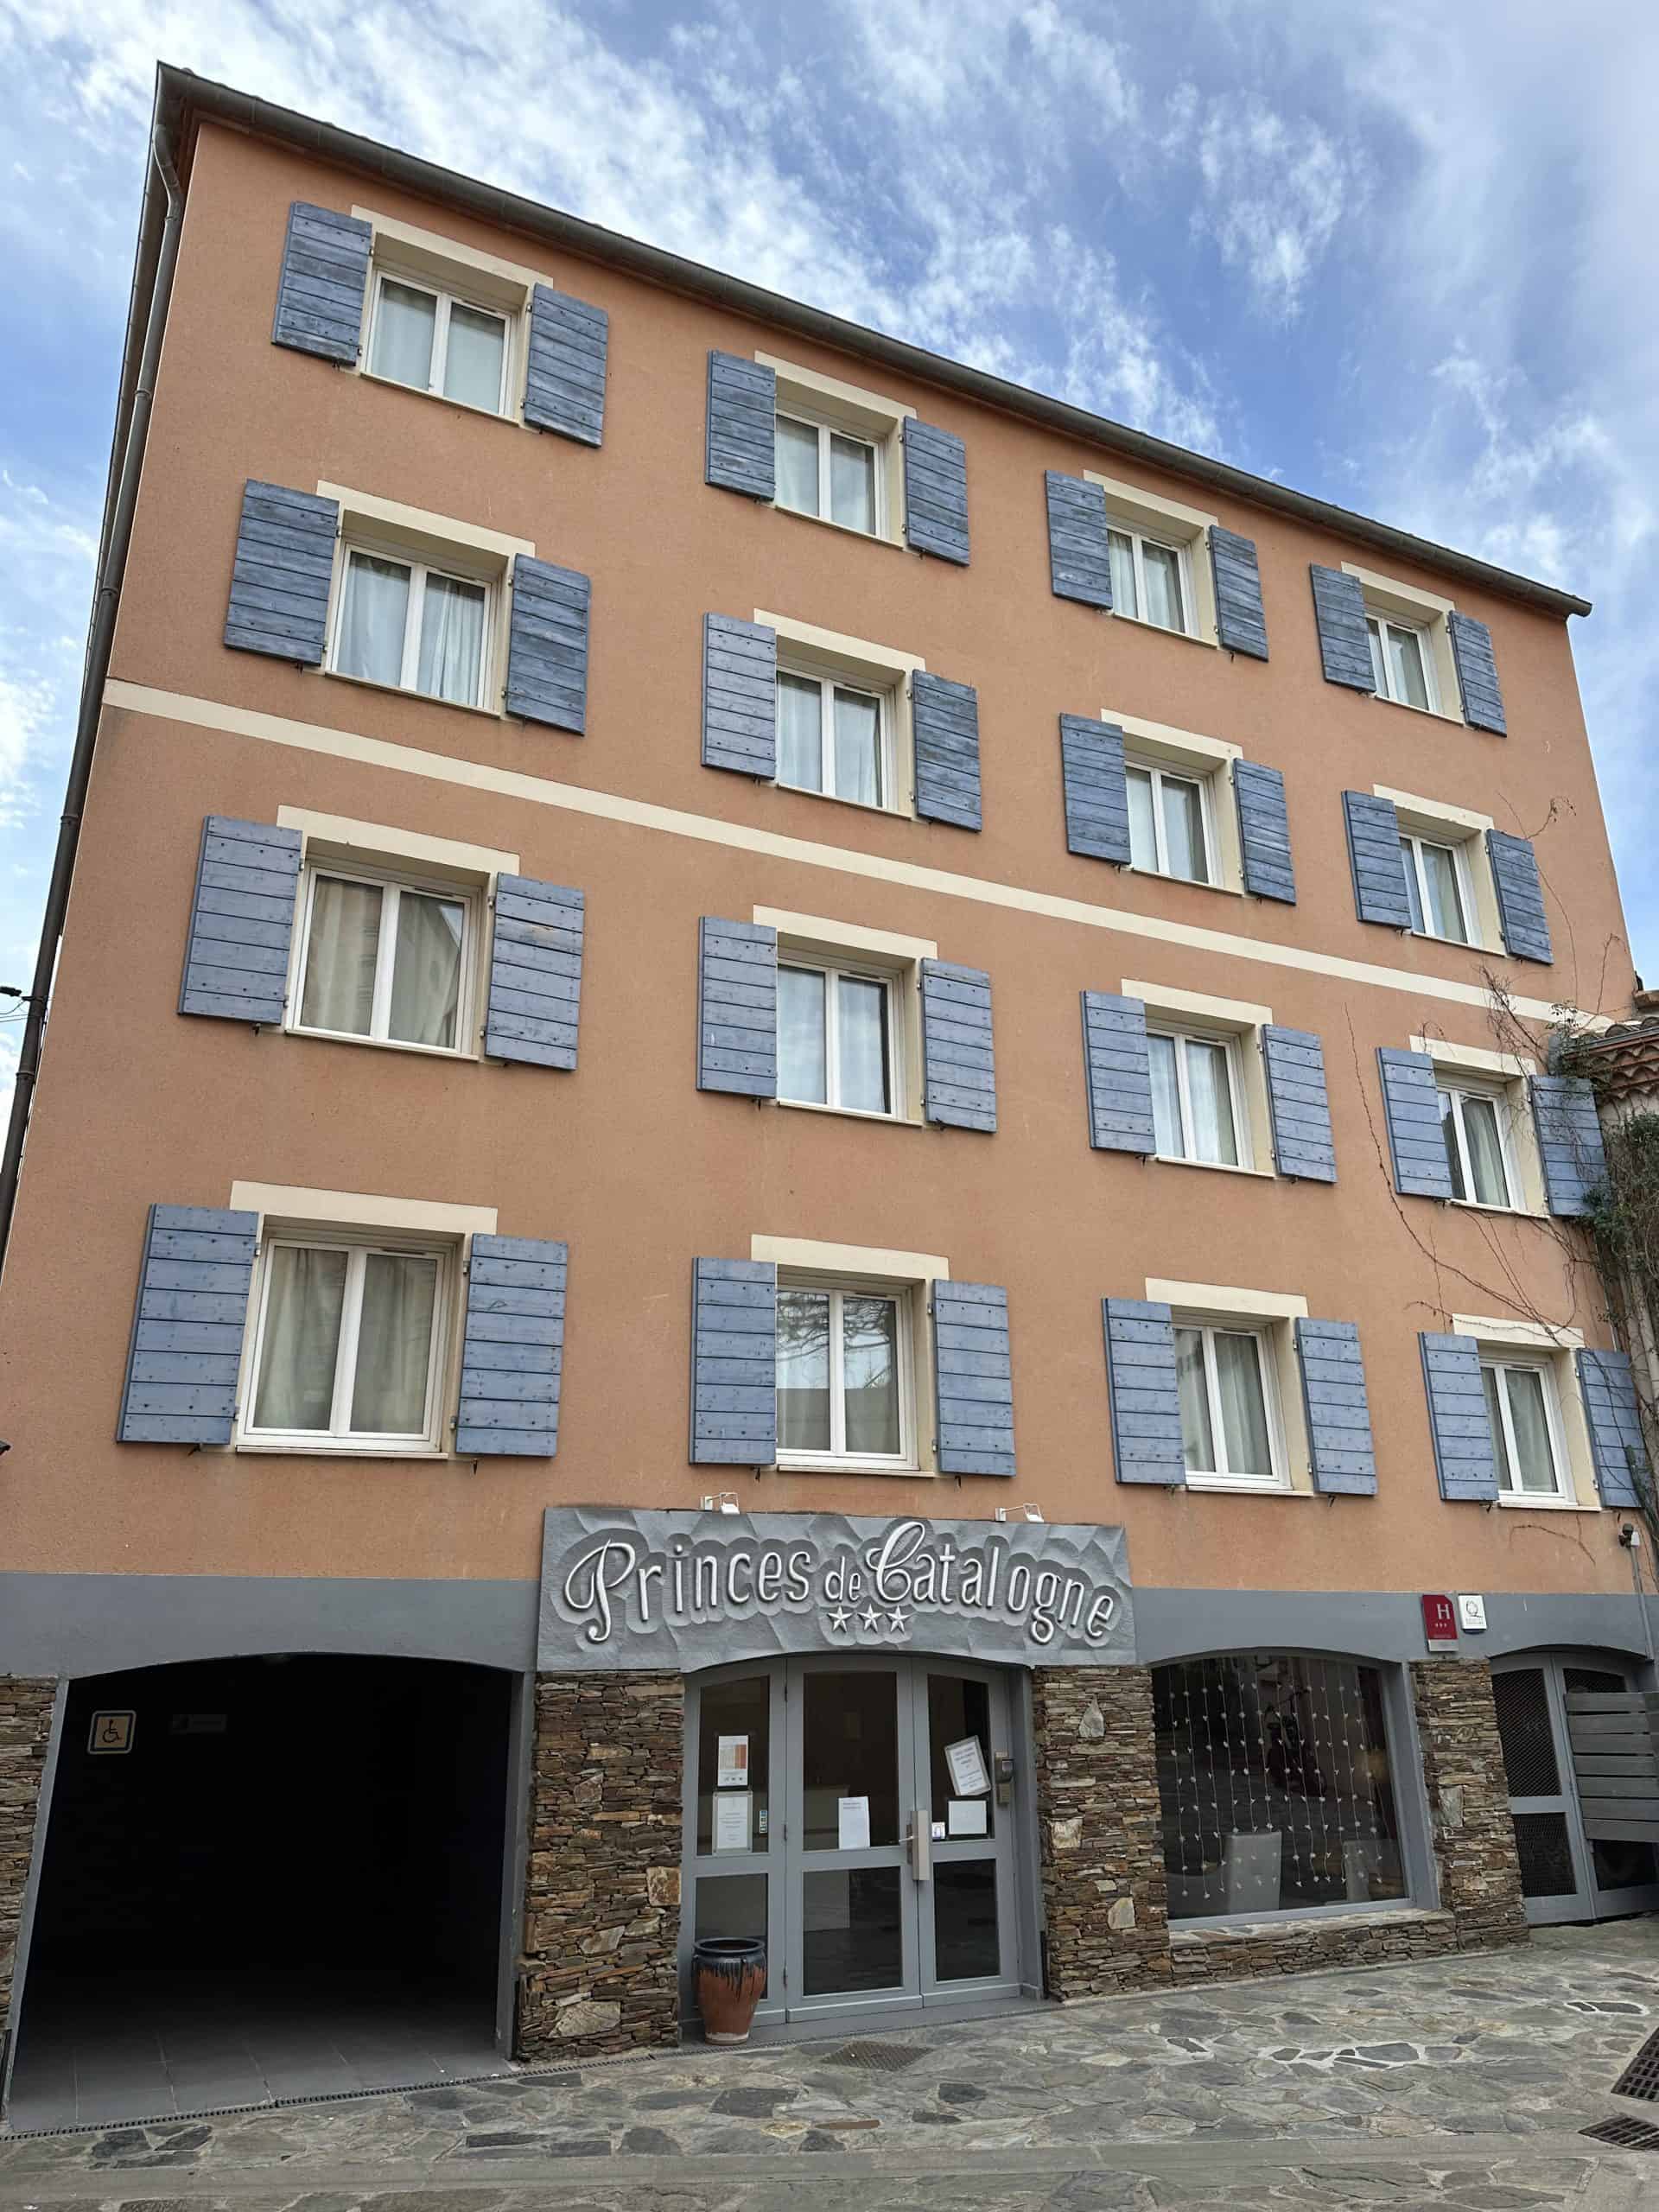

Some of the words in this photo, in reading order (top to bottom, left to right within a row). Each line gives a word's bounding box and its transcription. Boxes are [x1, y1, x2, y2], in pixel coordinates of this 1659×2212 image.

[564, 1538, 810, 1643] Princes
[823, 1555, 861, 1602] de
[865, 1521, 1114, 1644] Catalogne
[1436, 1603, 1451, 1619] H
